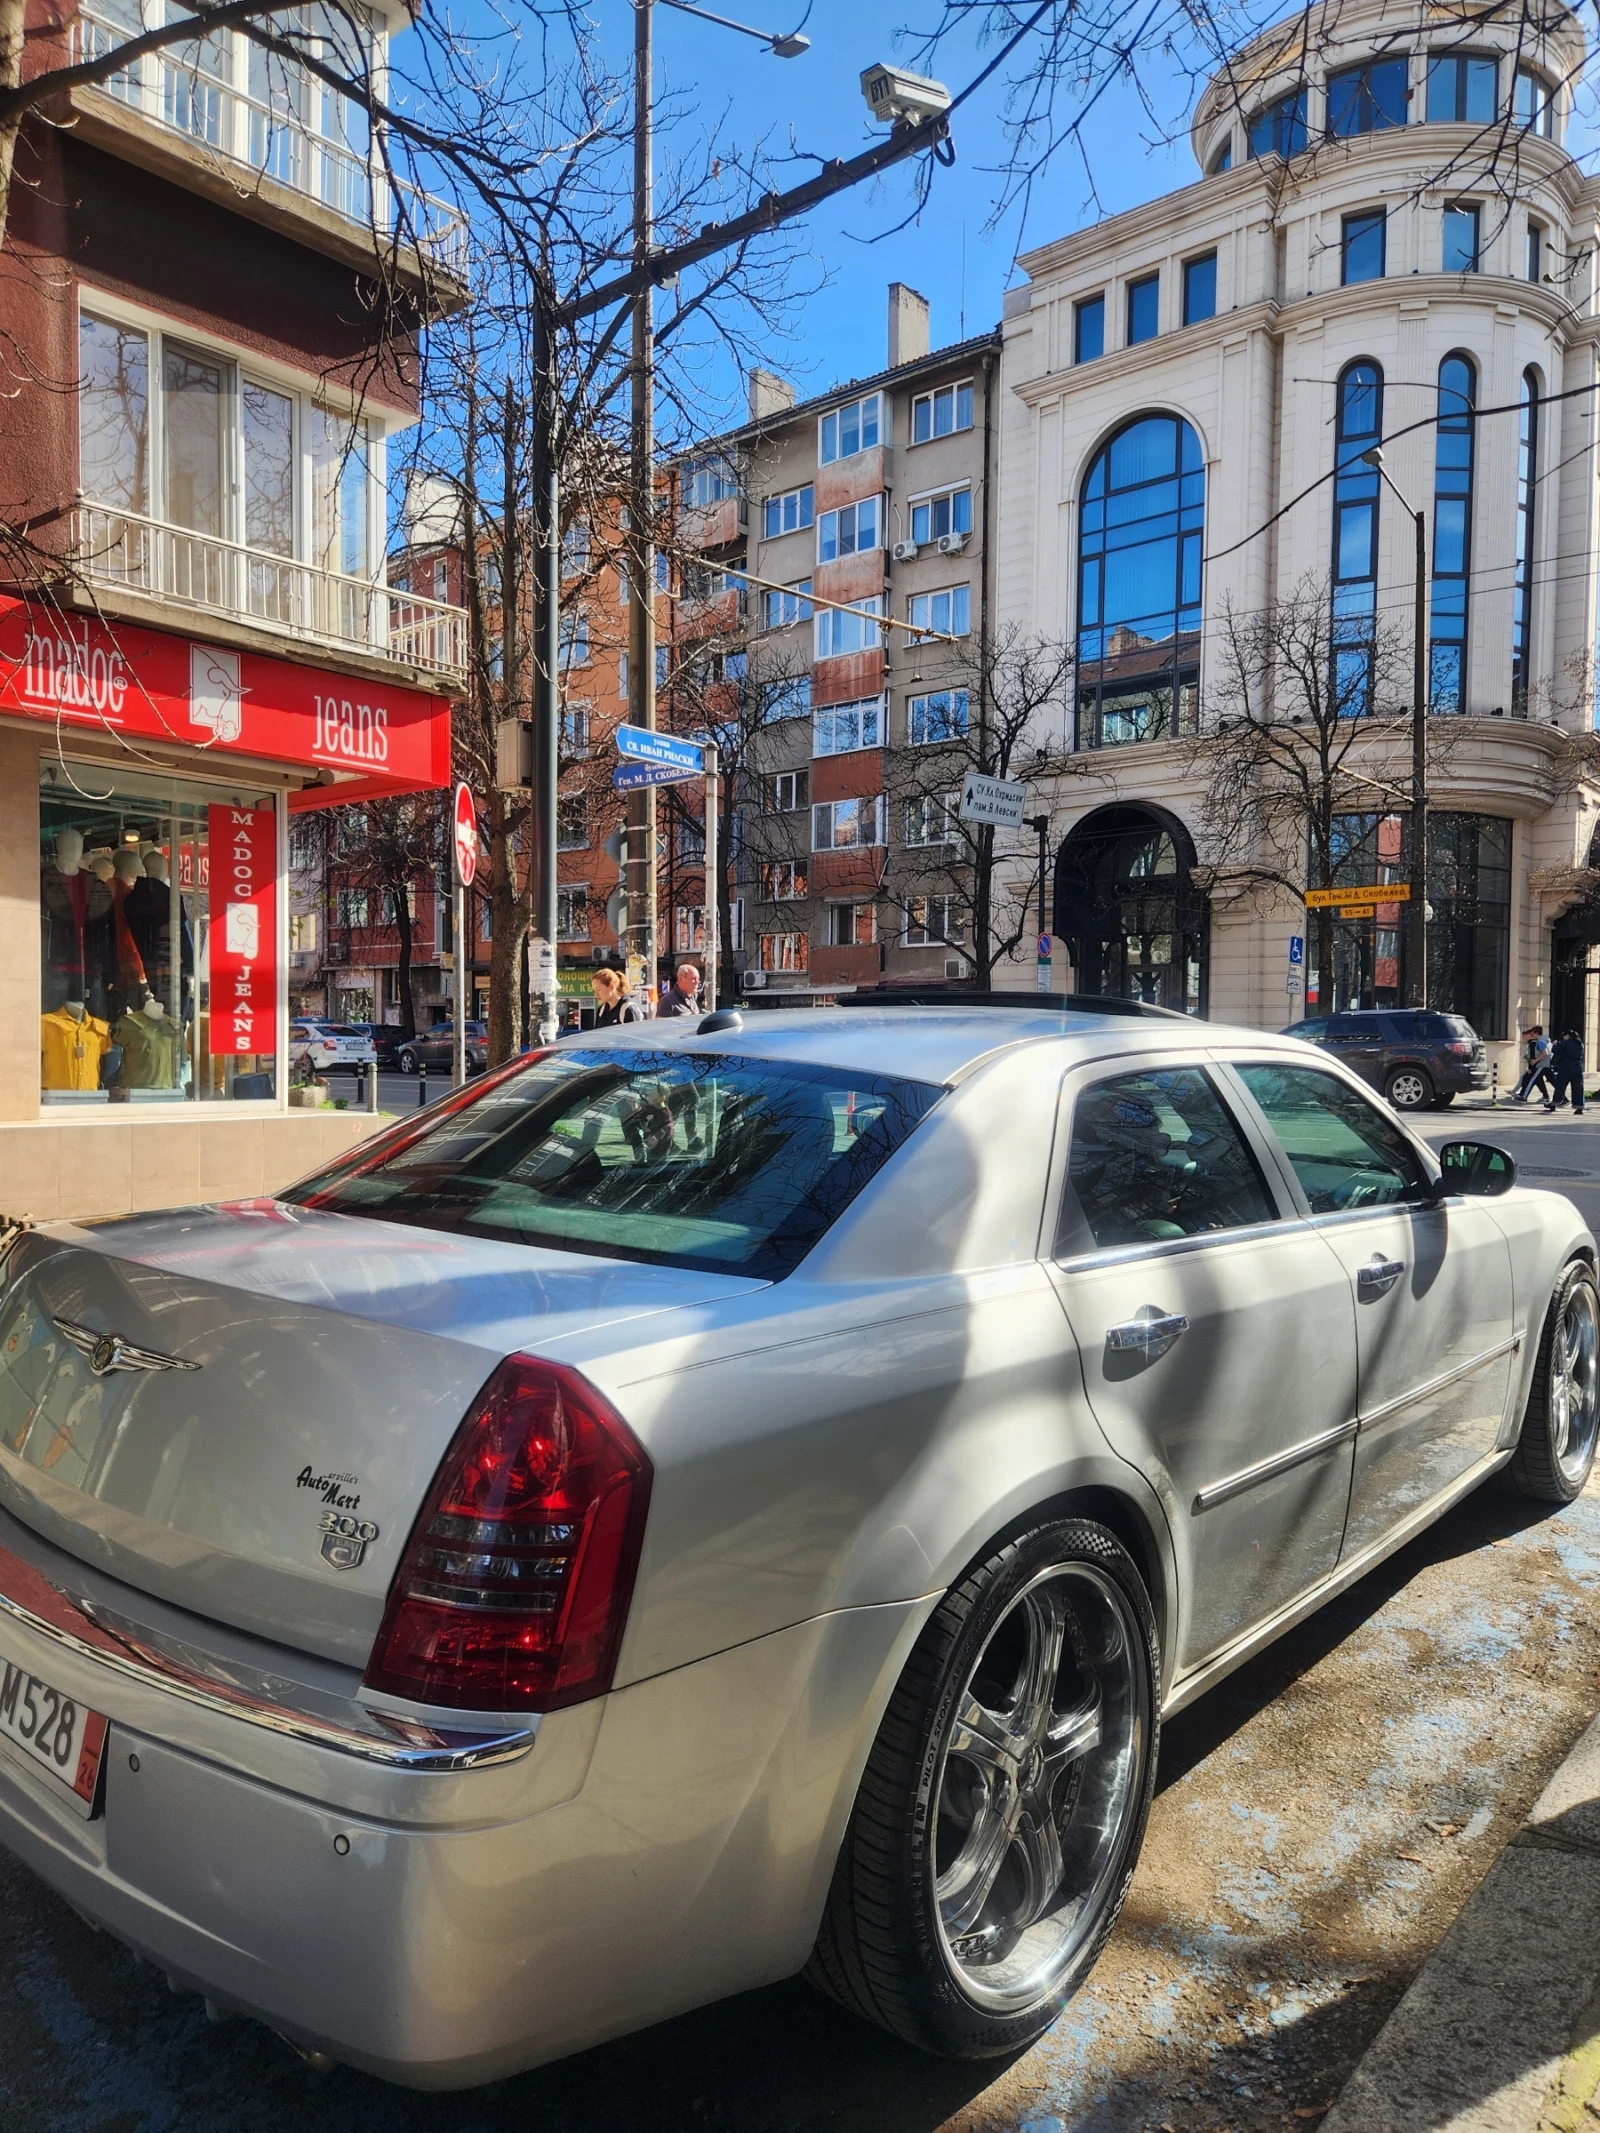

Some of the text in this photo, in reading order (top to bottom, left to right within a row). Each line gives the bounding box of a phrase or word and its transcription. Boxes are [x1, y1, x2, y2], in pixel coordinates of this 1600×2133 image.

[25, 618, 388, 761] madoc jeans
[641, 744, 662, 758] ИВАН
[664, 750, 693, 766] РИЛСКИ
[1363, 888, 1405, 898] Скобелев
[231, 811, 254, 1050] MADOC JEANS
[296, 1465, 330, 1491] Auto
[321, 1482, 361, 1510] Mart
[316, 1510, 379, 1542] 300
[329, 1546, 349, 1564] C
[922, 1743, 938, 1788] PILOT
[934, 1690, 952, 1739] SPORT
[78, 1762, 94, 1790] 26
